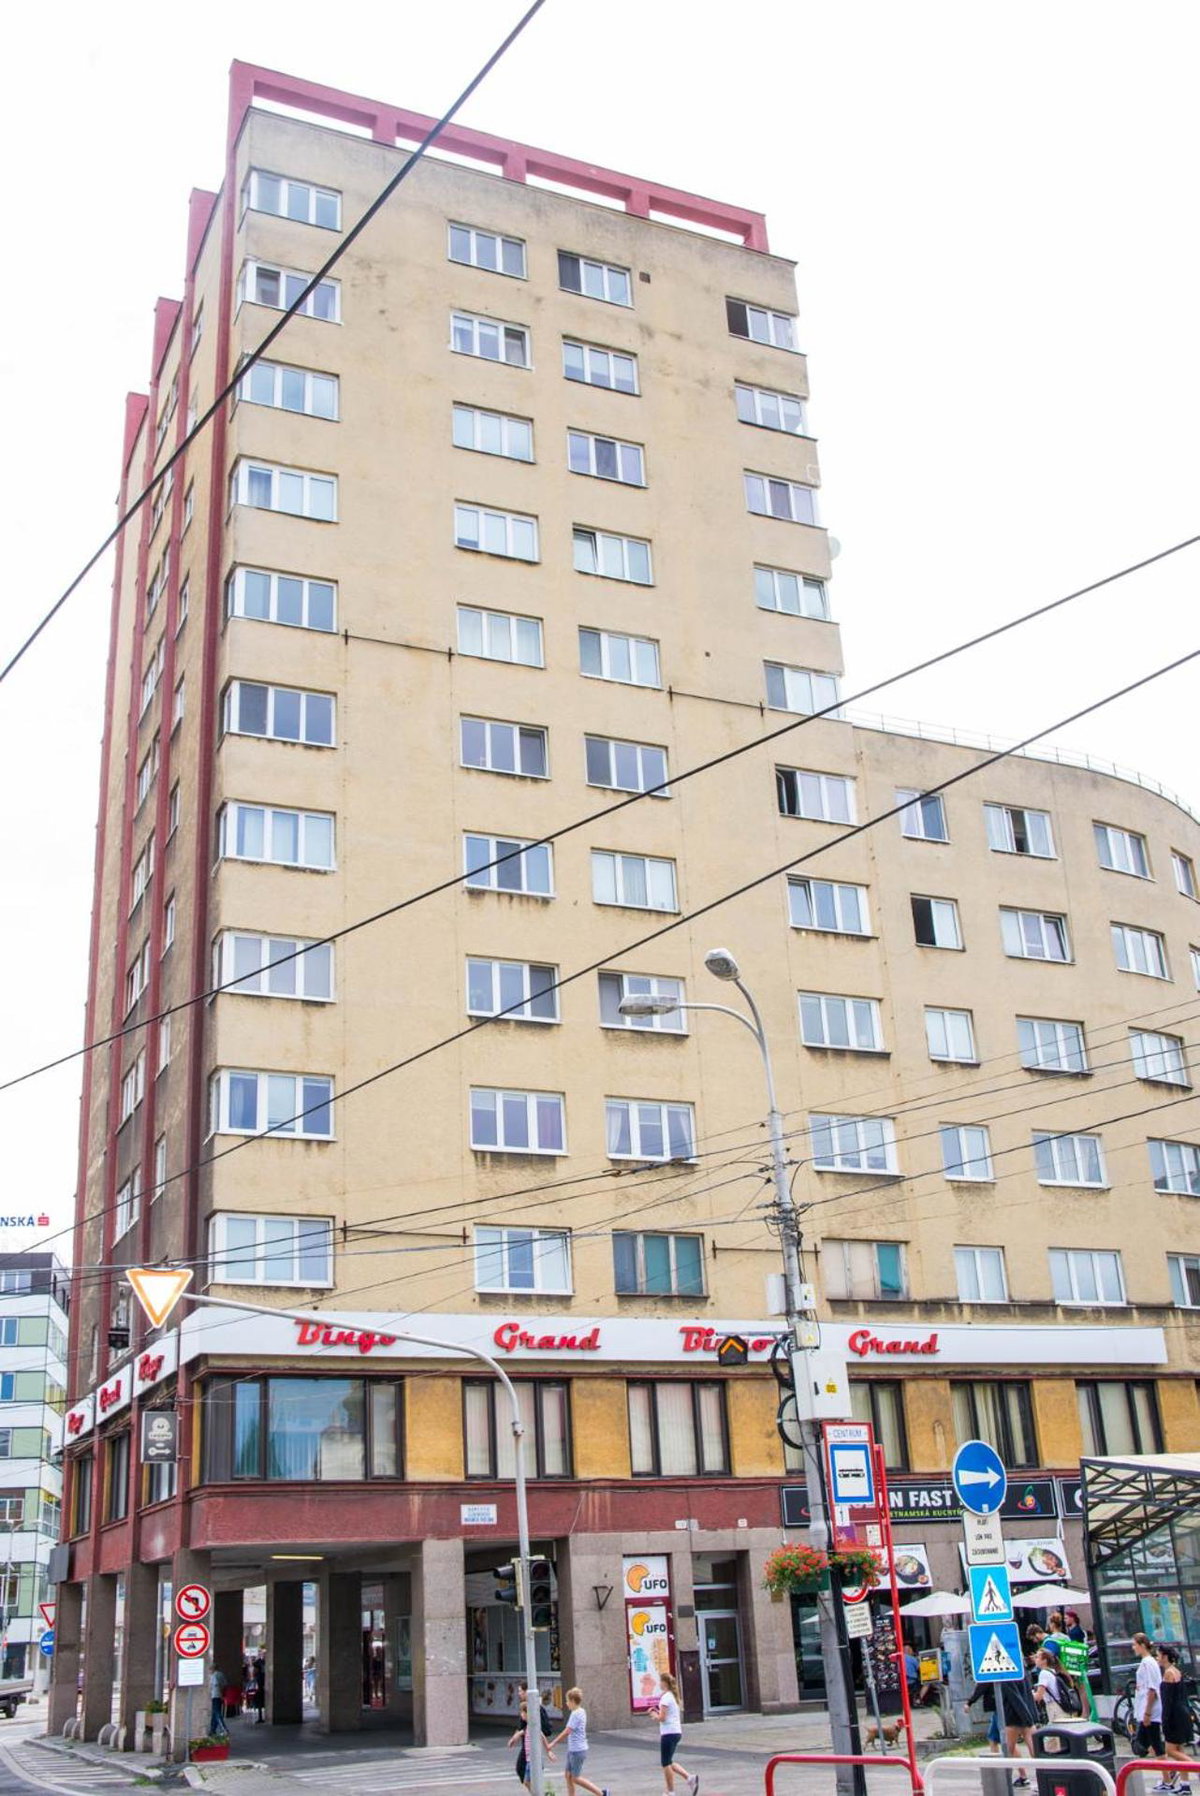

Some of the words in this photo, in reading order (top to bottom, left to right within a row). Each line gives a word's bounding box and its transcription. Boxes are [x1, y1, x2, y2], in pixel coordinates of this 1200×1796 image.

[294, 1318, 397, 1354] Bingo
[494, 1322, 602, 1352] Grand
[679, 1326, 777, 1353] Bio
[849, 1329, 941, 1357] Grand
[908, 1490, 953, 1508] FAST
[644, 1579, 668, 1590] UFO
[646, 1623, 667, 1634] UFO
